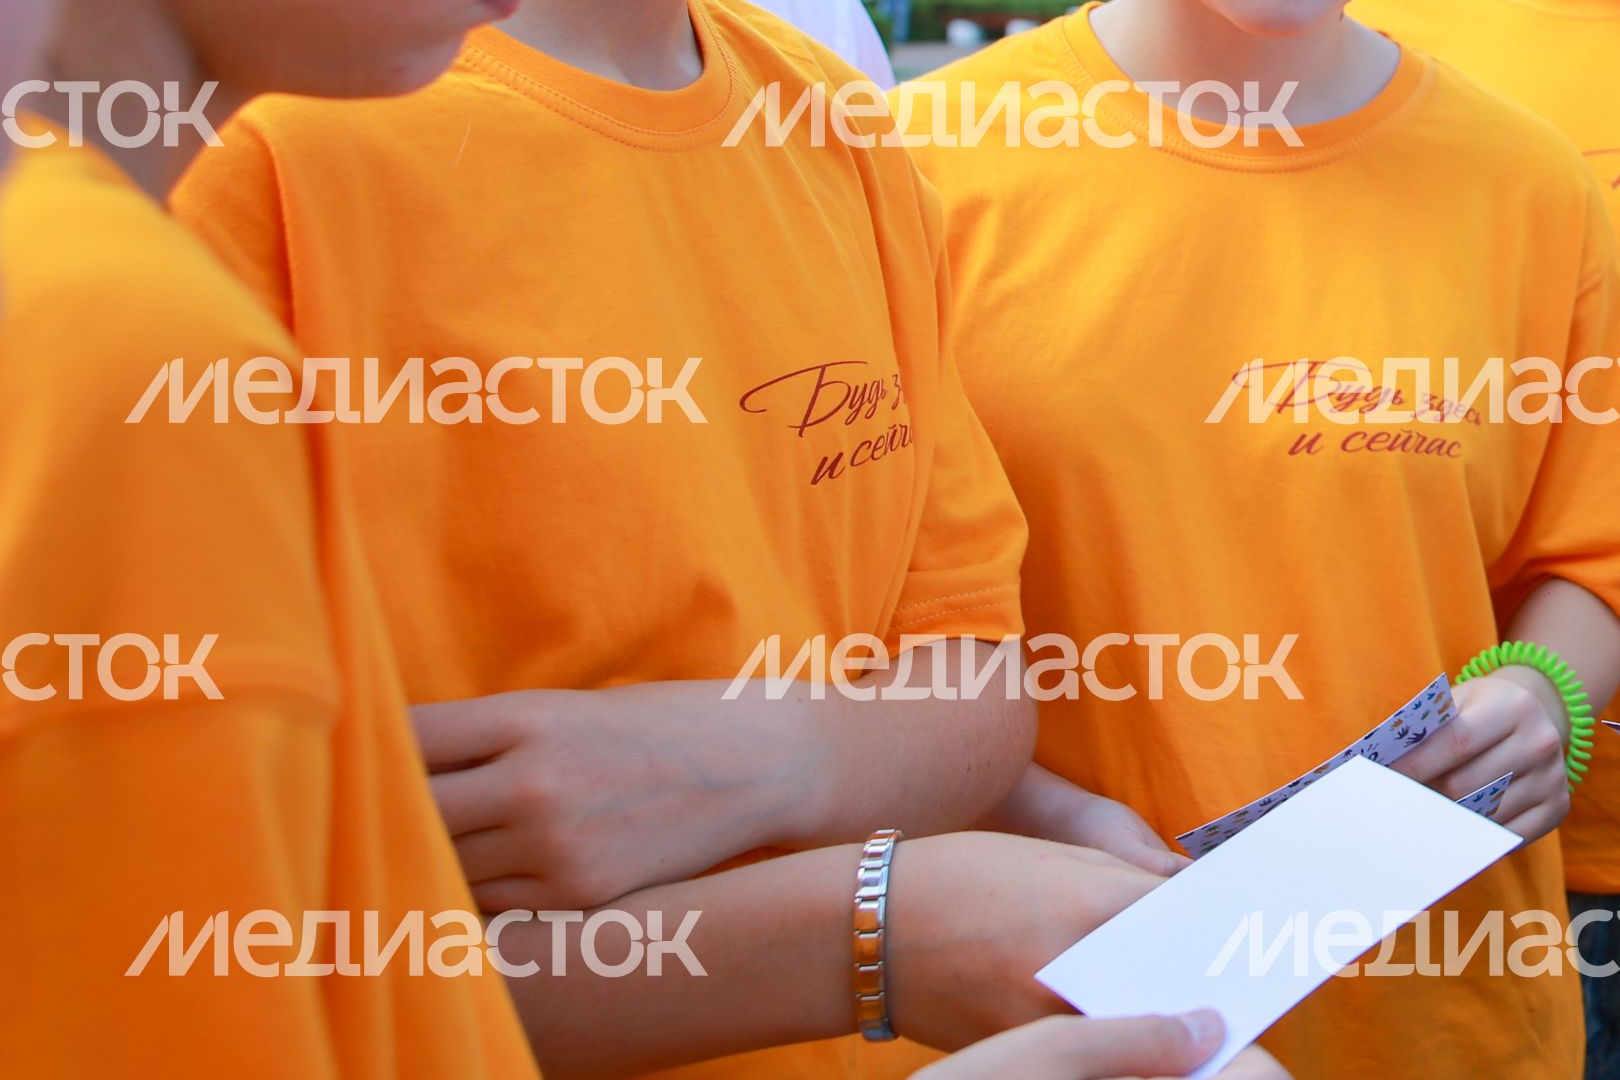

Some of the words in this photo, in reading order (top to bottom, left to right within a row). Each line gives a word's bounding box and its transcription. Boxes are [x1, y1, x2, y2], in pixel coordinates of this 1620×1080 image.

[739, 360, 887, 438] Будь
[810, 452, 845, 486] и
[850, 423, 912, 467] сейч
[1287, 432, 1325, 456] и
[1340, 428, 1463, 459] сейчас
